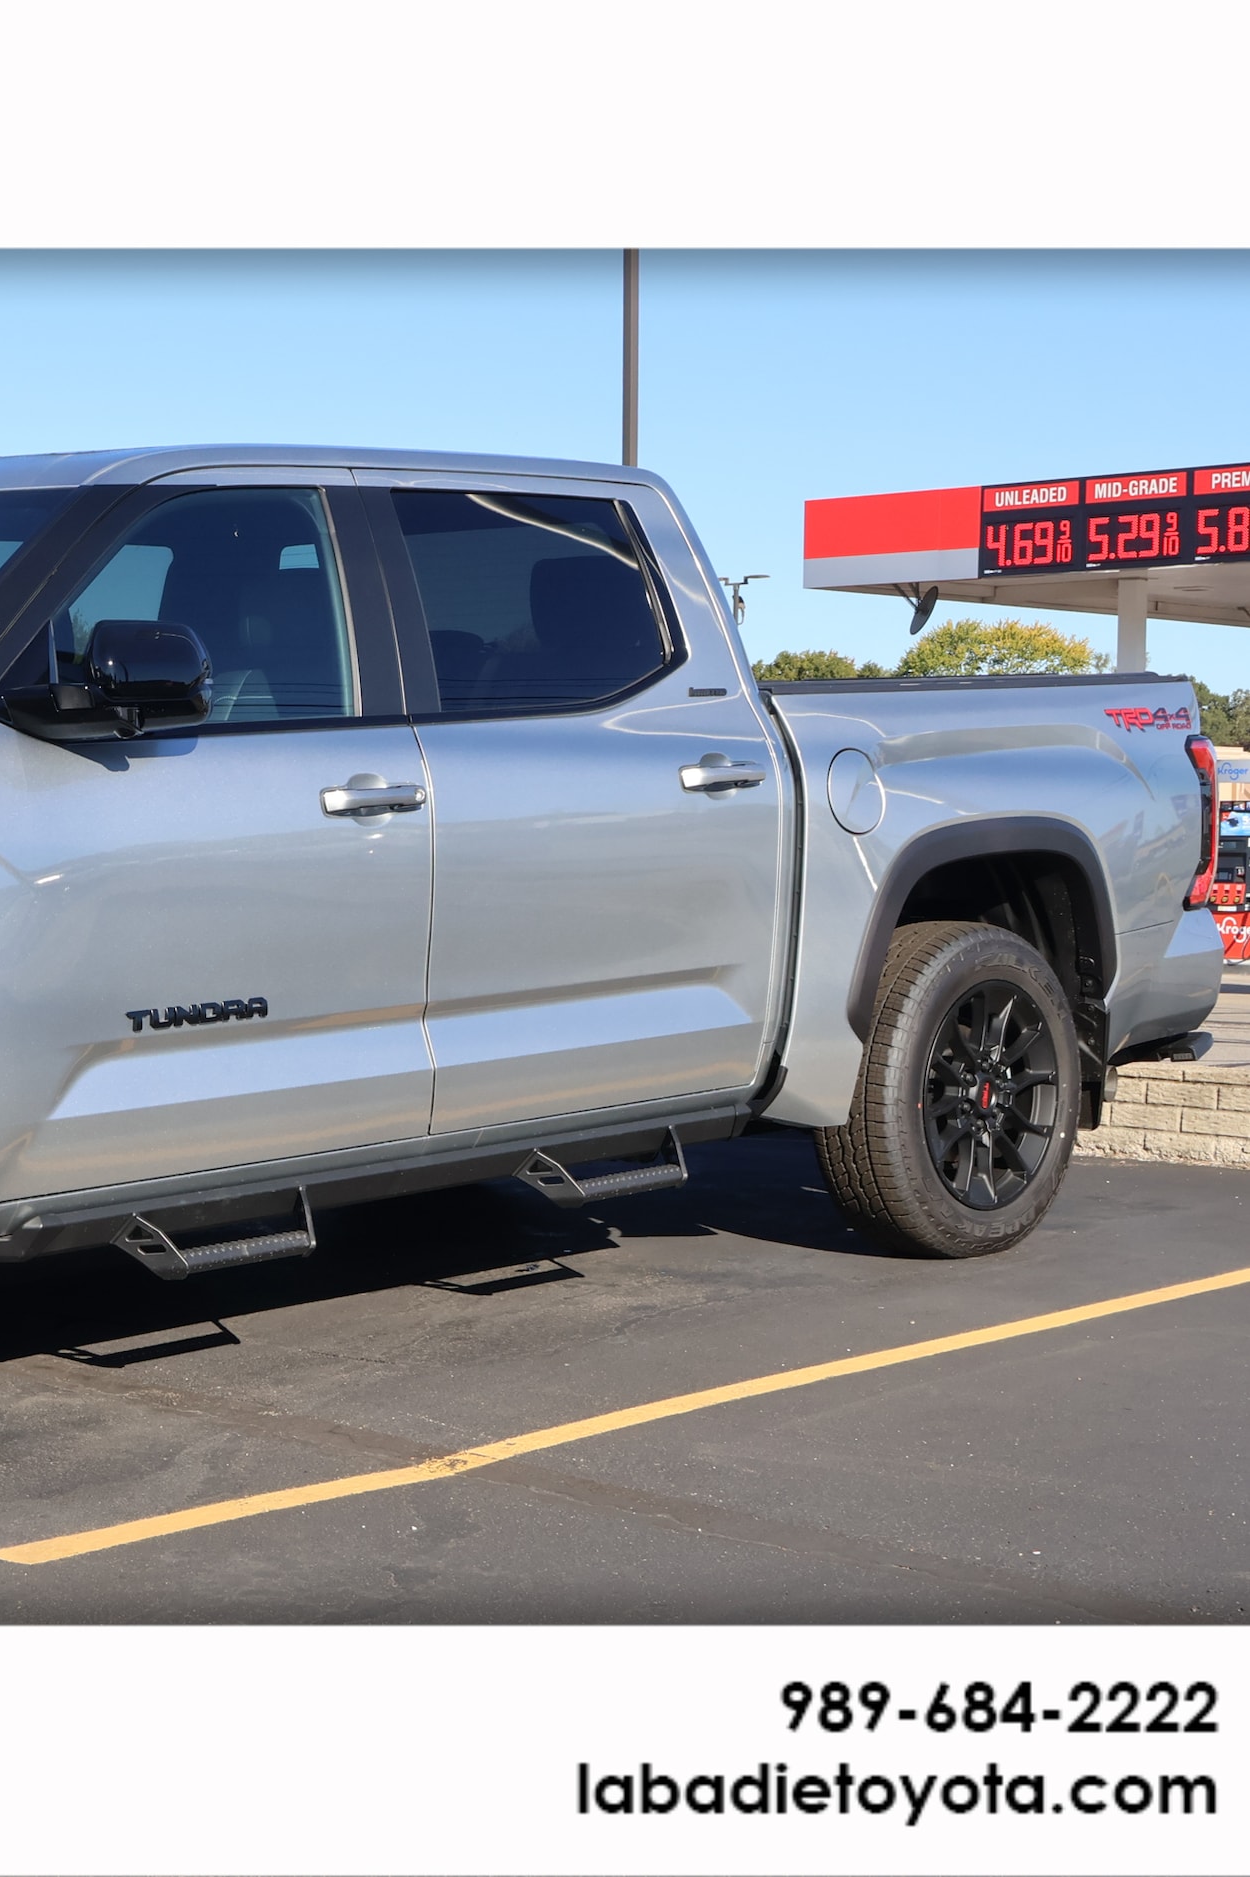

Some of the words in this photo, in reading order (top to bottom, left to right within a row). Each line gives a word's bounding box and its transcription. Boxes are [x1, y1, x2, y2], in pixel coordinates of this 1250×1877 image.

[1094, 476, 1178, 500] MID-GRADE
[1211, 470, 1250, 490] PREM
[994, 486, 1067, 508] UNLEADED
[985, 520, 1055, 567] 4.69
[1088, 512, 1160, 561] 5.29
[1103, 707, 1155, 733] TRD
[1217, 762, 1249, 781] Kroger
[124, 996, 269, 1033] TUNDRA
